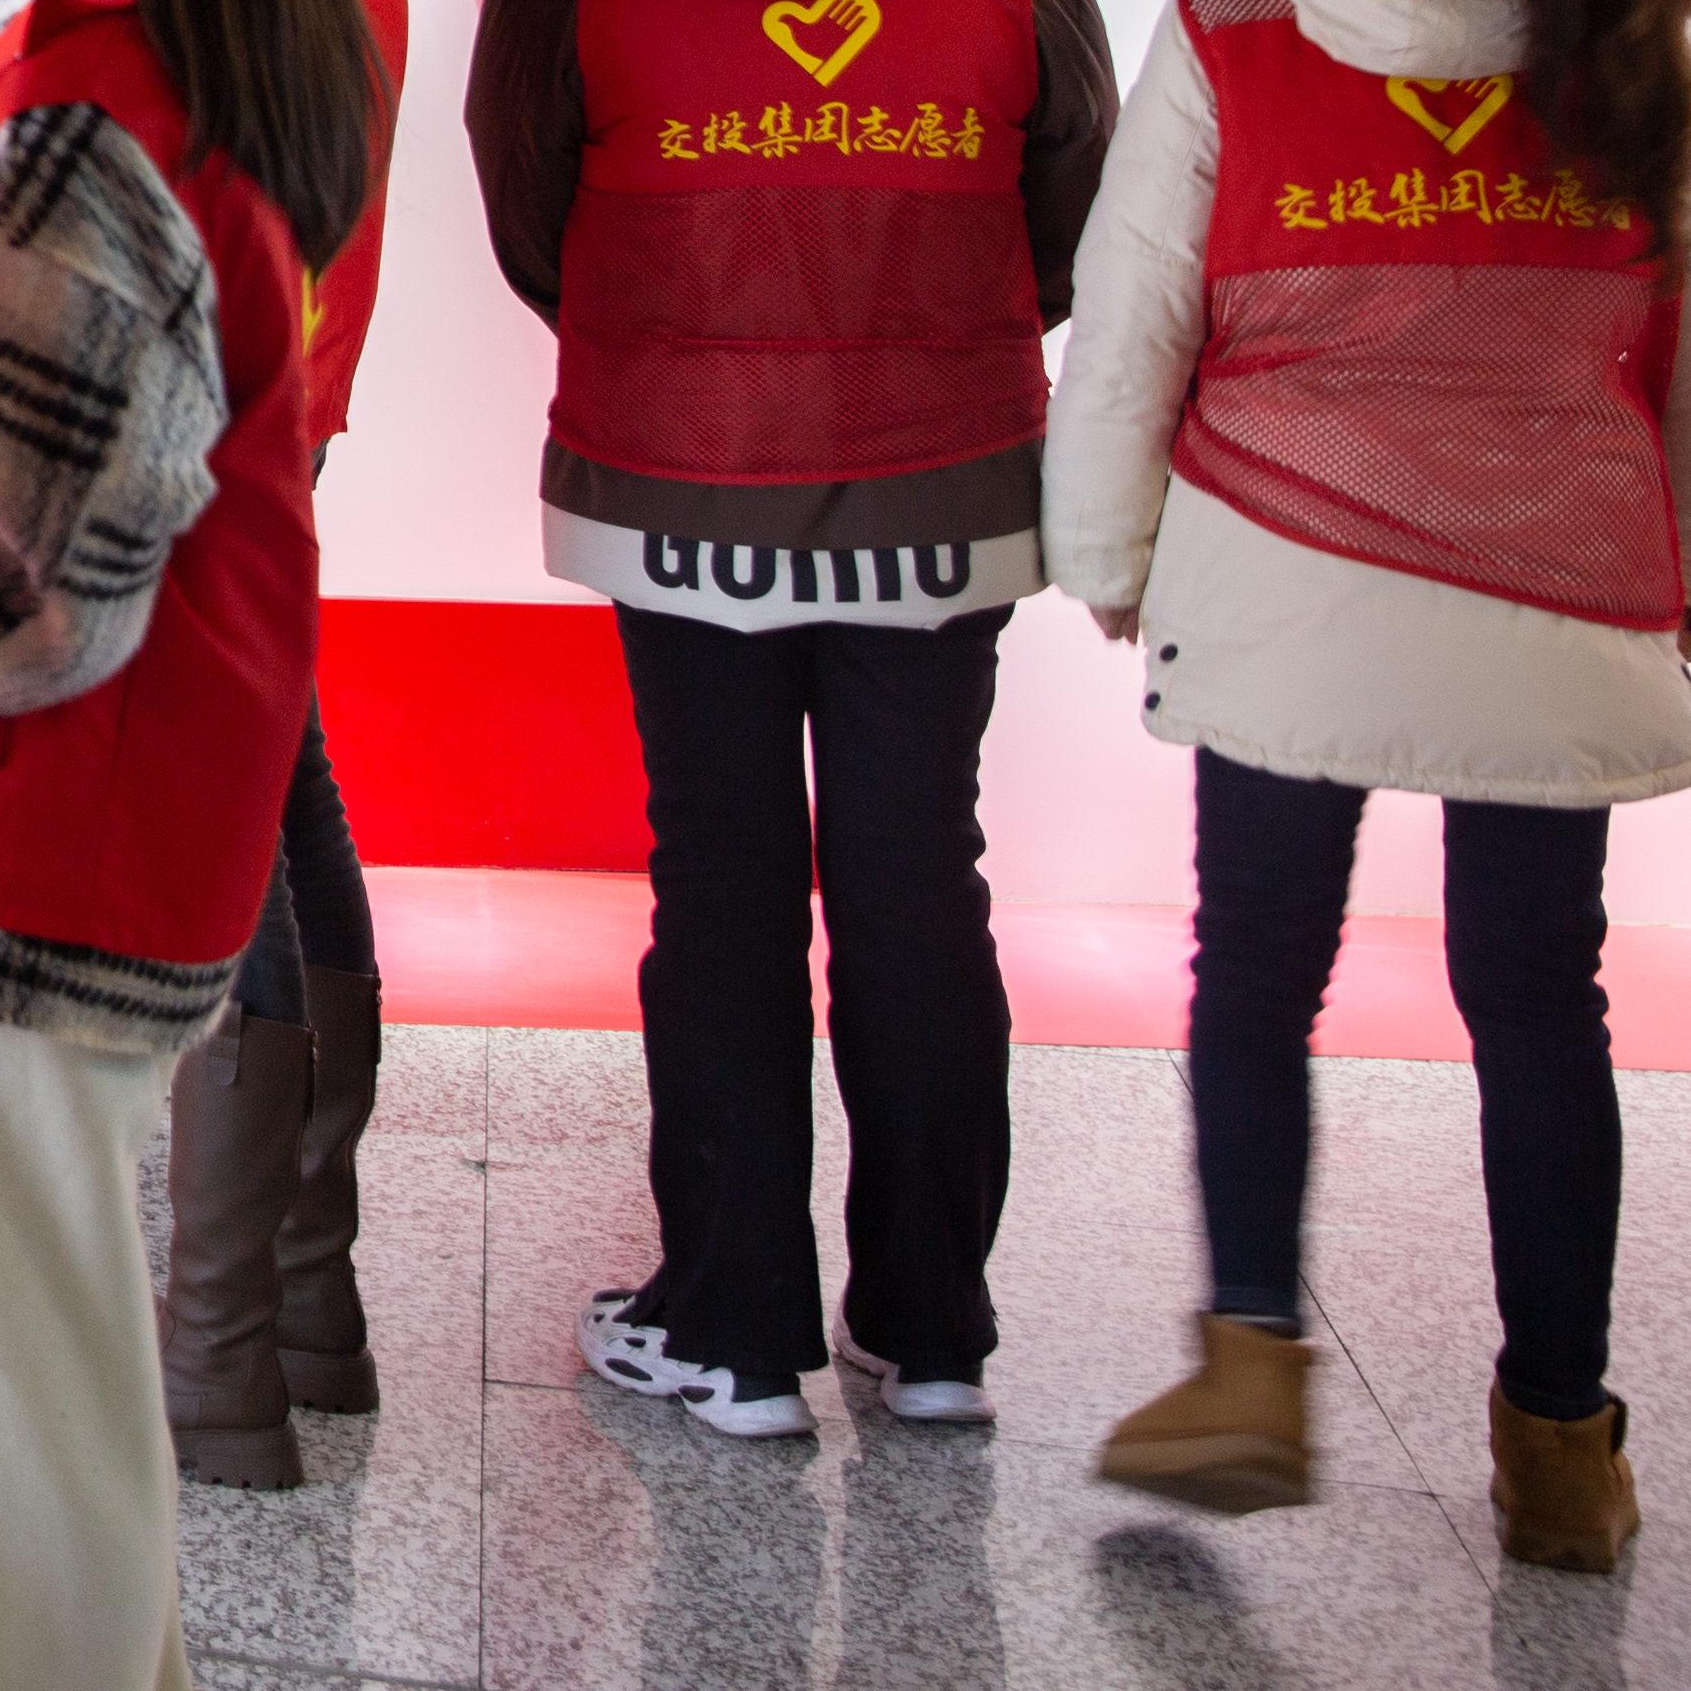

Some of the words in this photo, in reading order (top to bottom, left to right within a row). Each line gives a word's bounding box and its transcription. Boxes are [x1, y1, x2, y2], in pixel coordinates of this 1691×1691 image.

[656, 100, 987, 161] 交投集团志愿者
